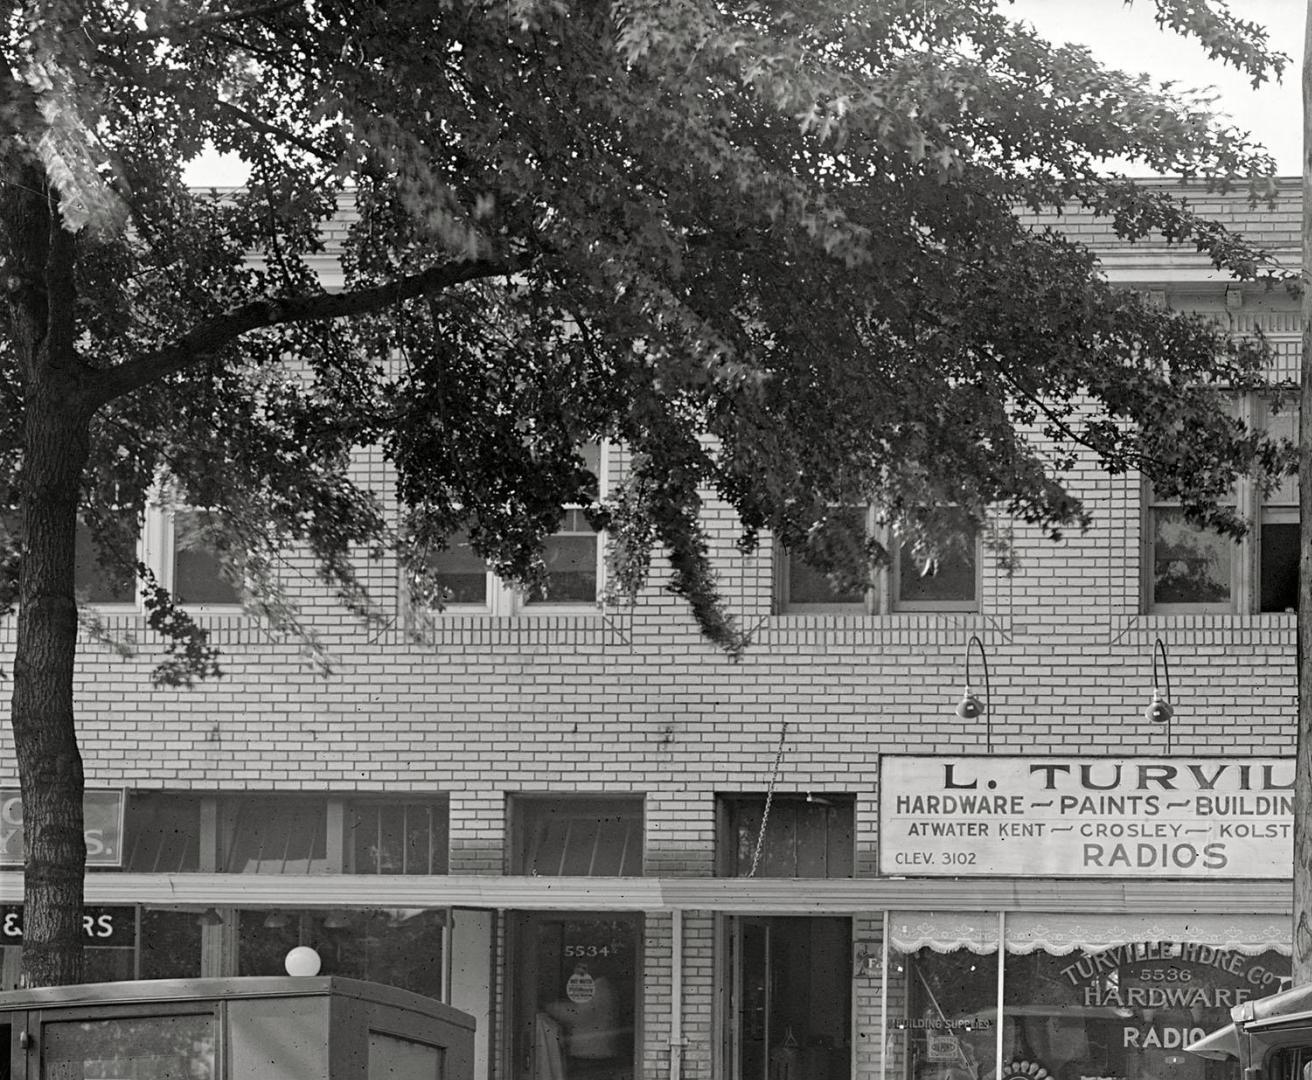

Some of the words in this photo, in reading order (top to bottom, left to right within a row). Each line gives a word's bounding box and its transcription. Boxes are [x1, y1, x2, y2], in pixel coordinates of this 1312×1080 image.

[943, 764, 997, 790] L.
[1030, 764, 1297, 791] TURVIL
[896, 795, 1024, 815] HARDWARE
[1060, 795, 1160, 816] PAINTS
[1196, 795, 1296, 816] BUILDIN
[908, 823, 989, 837] ATWATER
[999, 823, 1046, 837] KENT
[1080, 823, 1183, 838] CROSLEY
[1220, 824, 1292, 838] KOLST
[895, 852, 934, 865] CLEV.
[942, 852, 977, 865] 3102
[1083, 843, 1228, 869] RADIOS
[564, 945, 610, 957] 5534
[1060, 941, 1174, 986] TURVILLE
[1139, 968, 1192, 982] 5536
[1084, 987, 1252, 1009] HARDWARE
[896, 1018, 942, 1030] BUILDING
[944, 1018, 990, 1030] SUPPLIES
